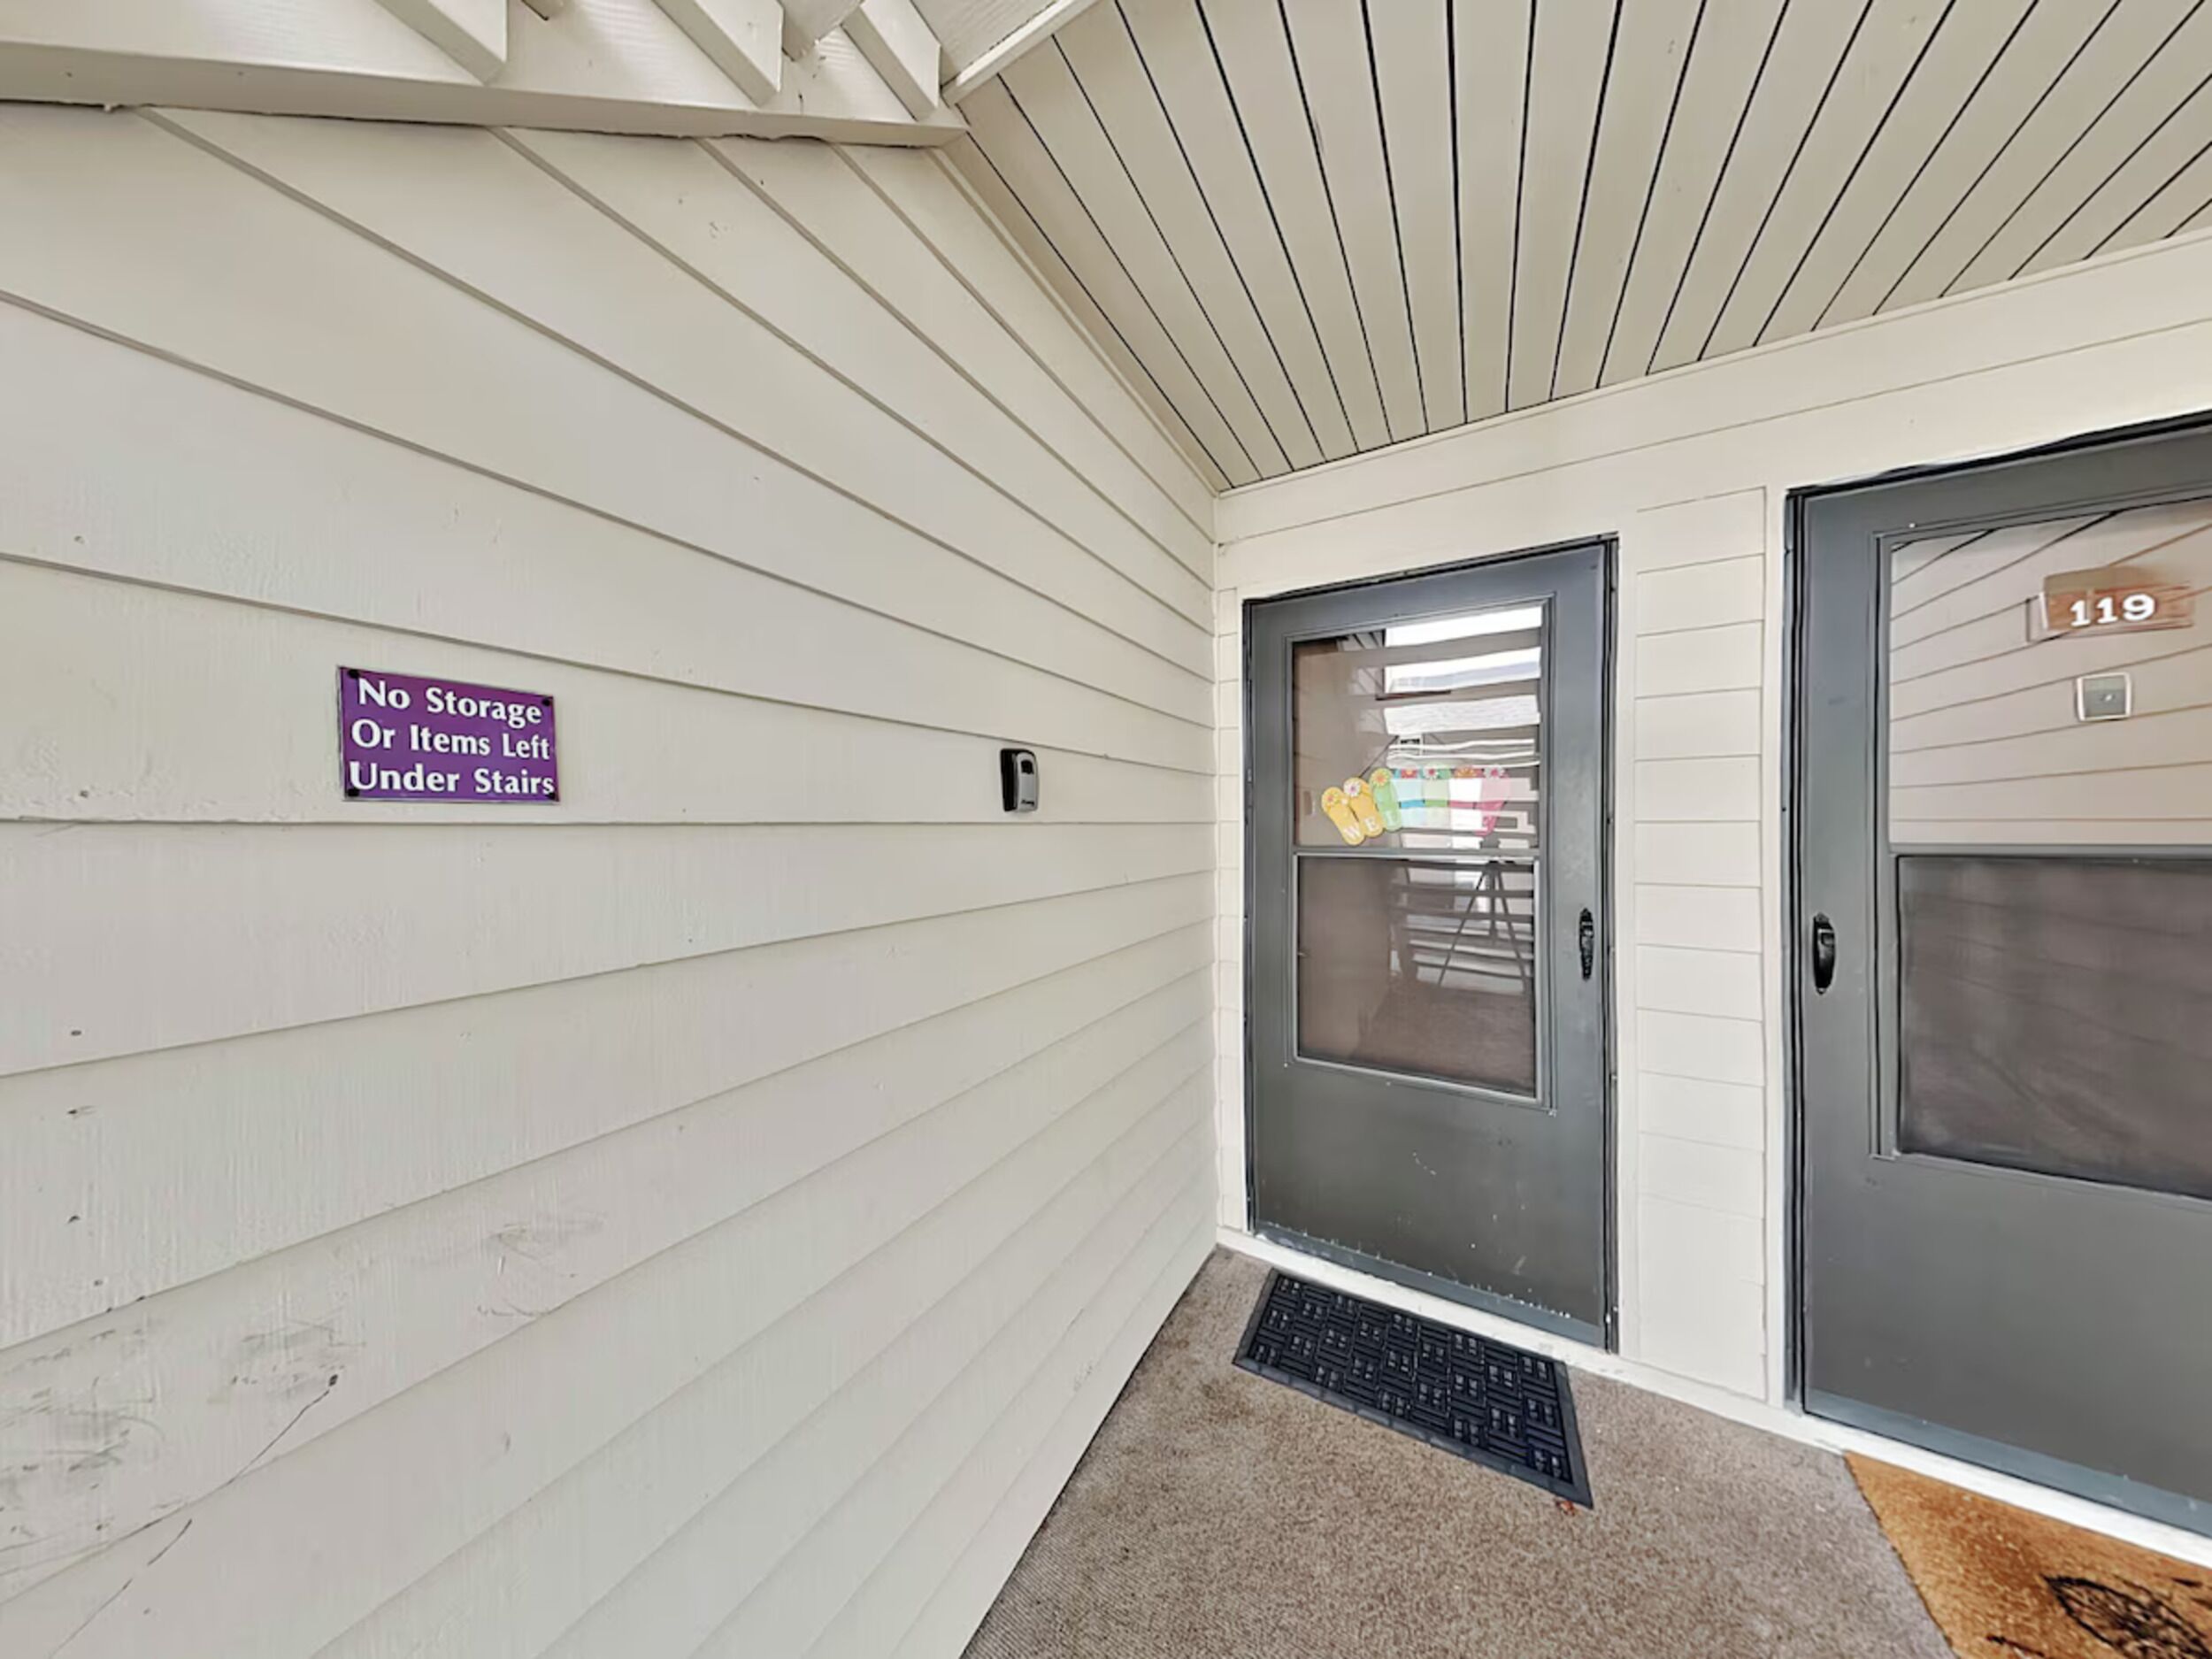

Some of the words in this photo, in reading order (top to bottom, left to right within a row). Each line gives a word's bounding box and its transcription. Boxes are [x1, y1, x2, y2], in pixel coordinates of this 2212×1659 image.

[2070, 593, 2155, 627] 119
[358, 678, 411, 709] No
[426, 687, 542, 729] Storage
[351, 718, 396, 749] Or
[410, 724, 490, 756] Items
[502, 733, 550, 760] Left
[349, 761, 460, 792] Under
[473, 767, 556, 795] Stairs
